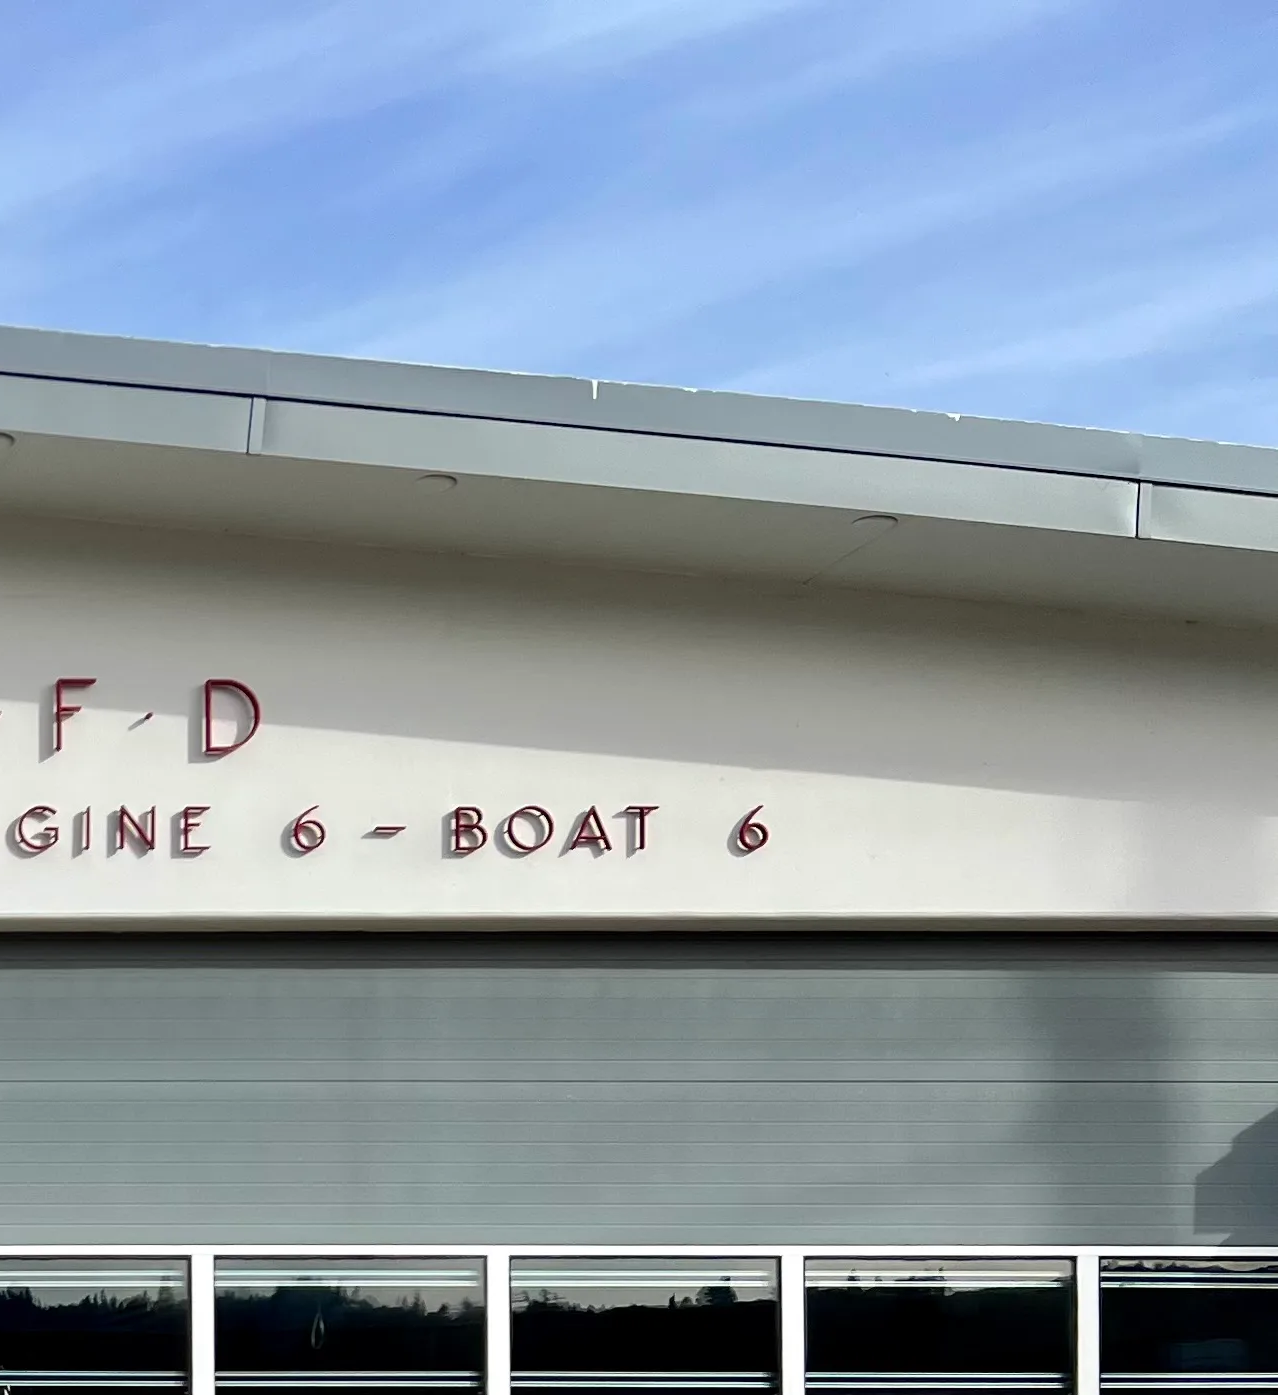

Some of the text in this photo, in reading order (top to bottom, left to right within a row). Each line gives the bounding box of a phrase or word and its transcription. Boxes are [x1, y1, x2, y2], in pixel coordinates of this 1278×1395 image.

[291, 804, 327, 852] 6
[453, 804, 660, 853] BOAT
[735, 804, 769, 852] 6
